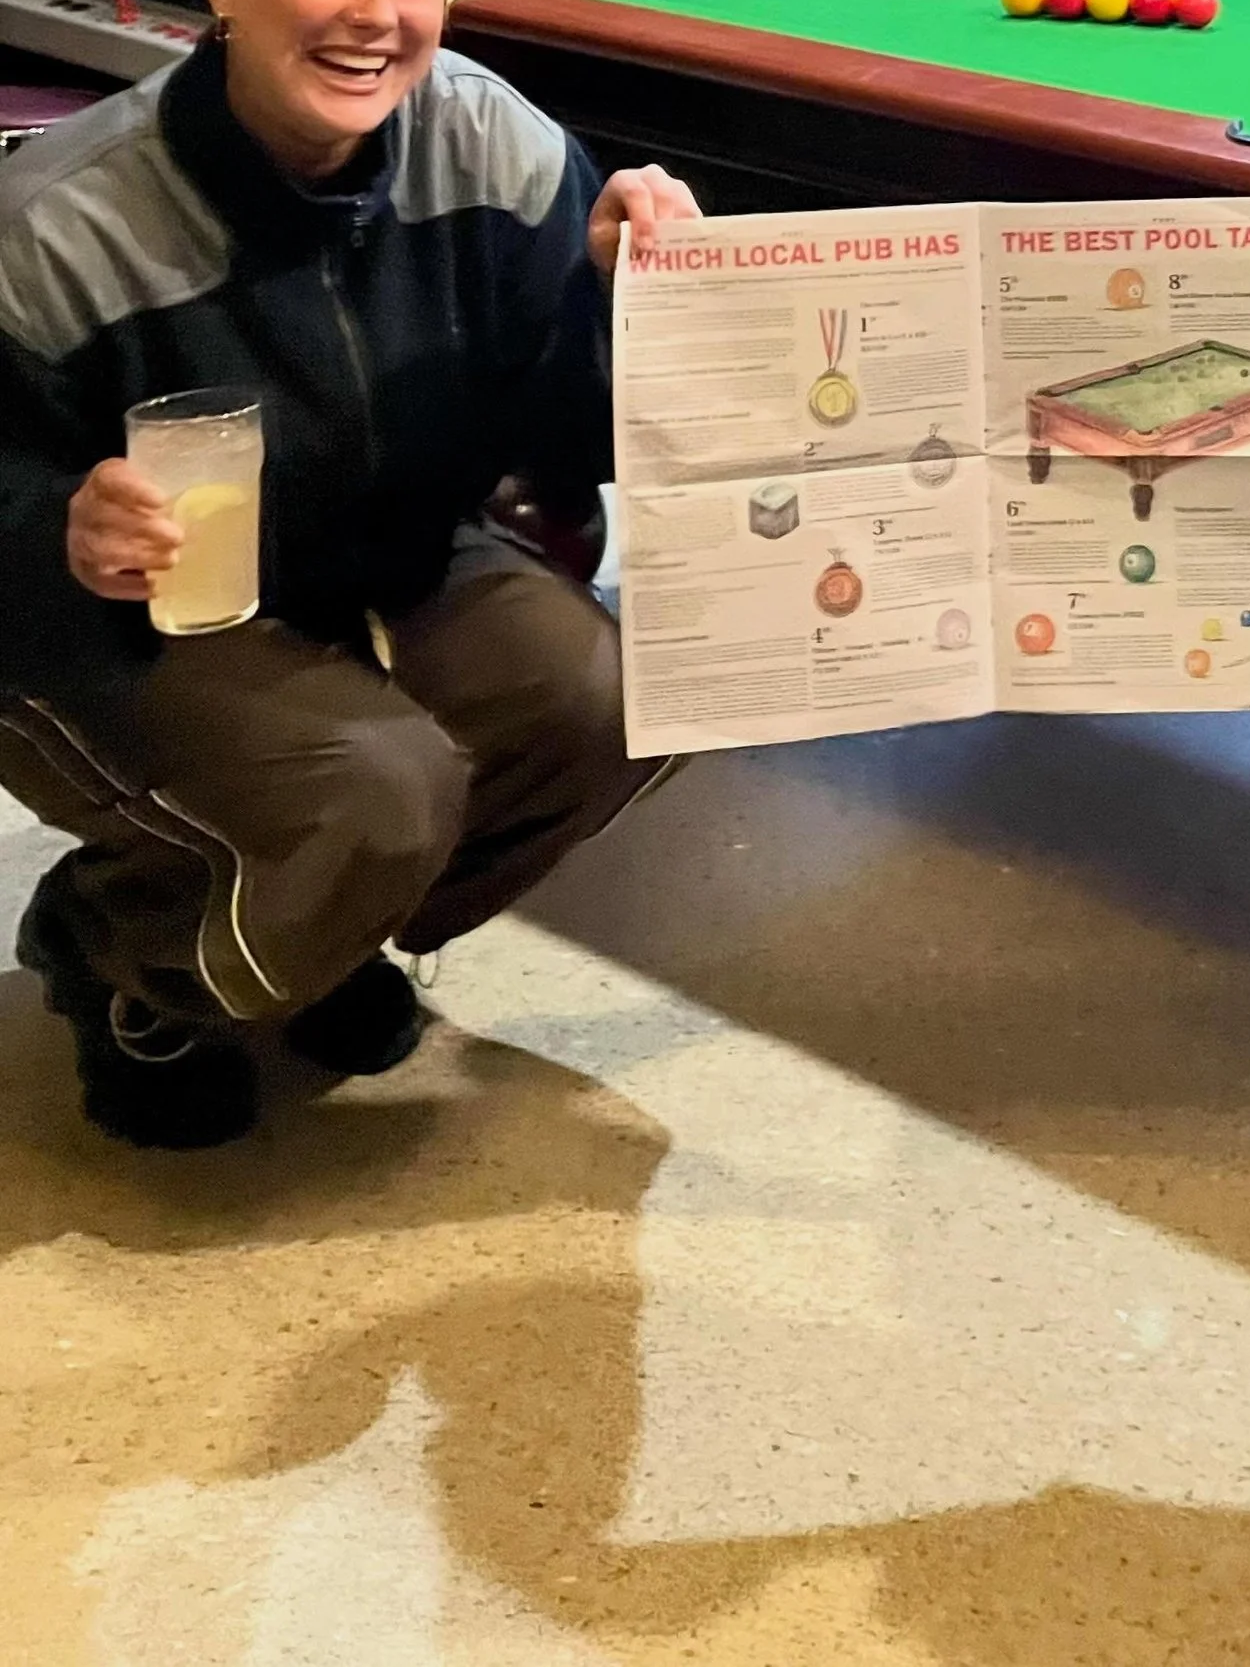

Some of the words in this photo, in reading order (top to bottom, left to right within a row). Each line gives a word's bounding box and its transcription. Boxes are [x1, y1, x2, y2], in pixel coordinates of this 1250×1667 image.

[628, 246, 723, 274] WHICH
[734, 242, 824, 269] LOCAL
[834, 238, 893, 262] PUB
[904, 233, 960, 259] HAS
[1001, 231, 1055, 253] THE
[1064, 230, 1135, 252] BEST
[1145, 227, 1218, 250] POOL
